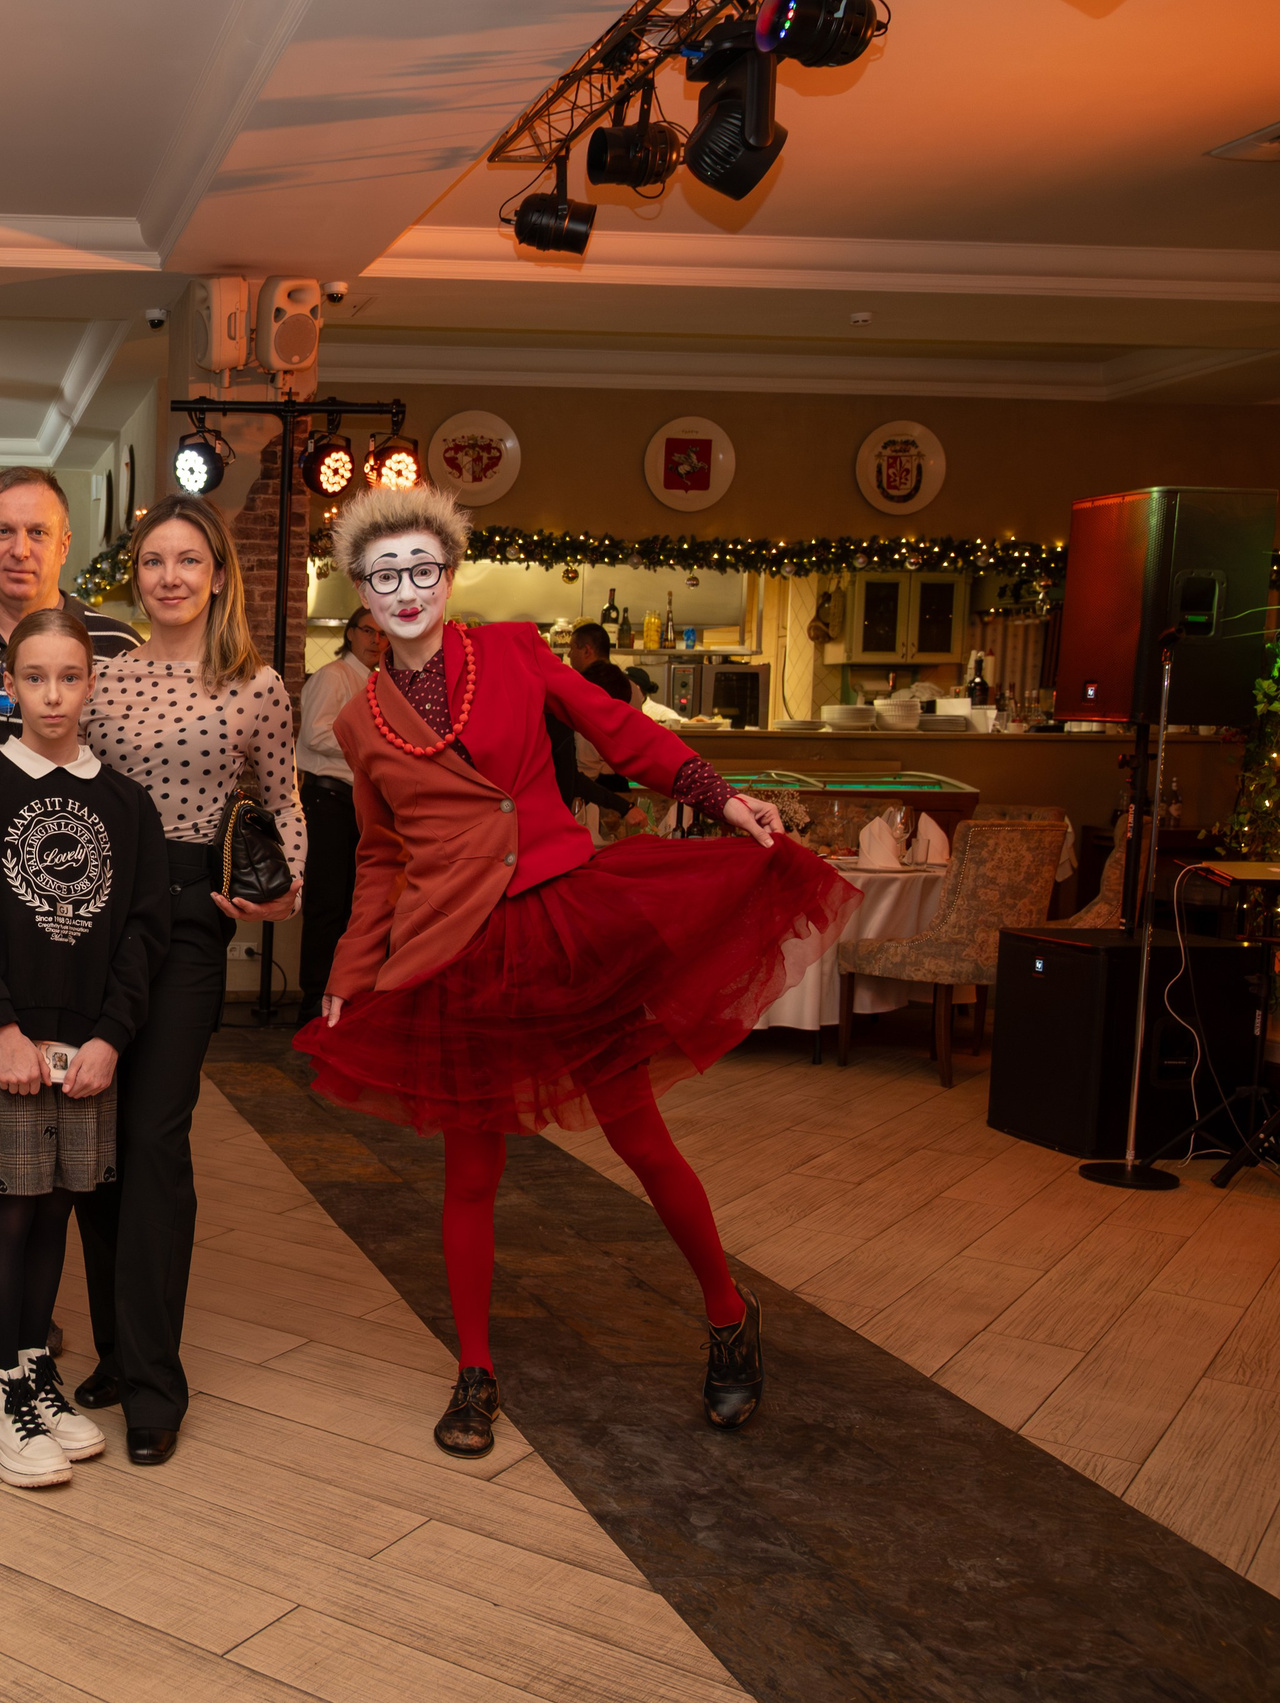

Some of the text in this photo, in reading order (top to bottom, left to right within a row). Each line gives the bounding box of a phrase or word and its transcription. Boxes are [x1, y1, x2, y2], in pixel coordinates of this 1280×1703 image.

[4, 797, 112, 856] MAKE IT HAPPEN
[27, 821, 100, 879] FALLING IN LOVE AGAIN
[39, 843, 87, 870] Lovely
[37, 873, 92, 895] SINCE 1988
[59, 906, 69, 914] GJ
